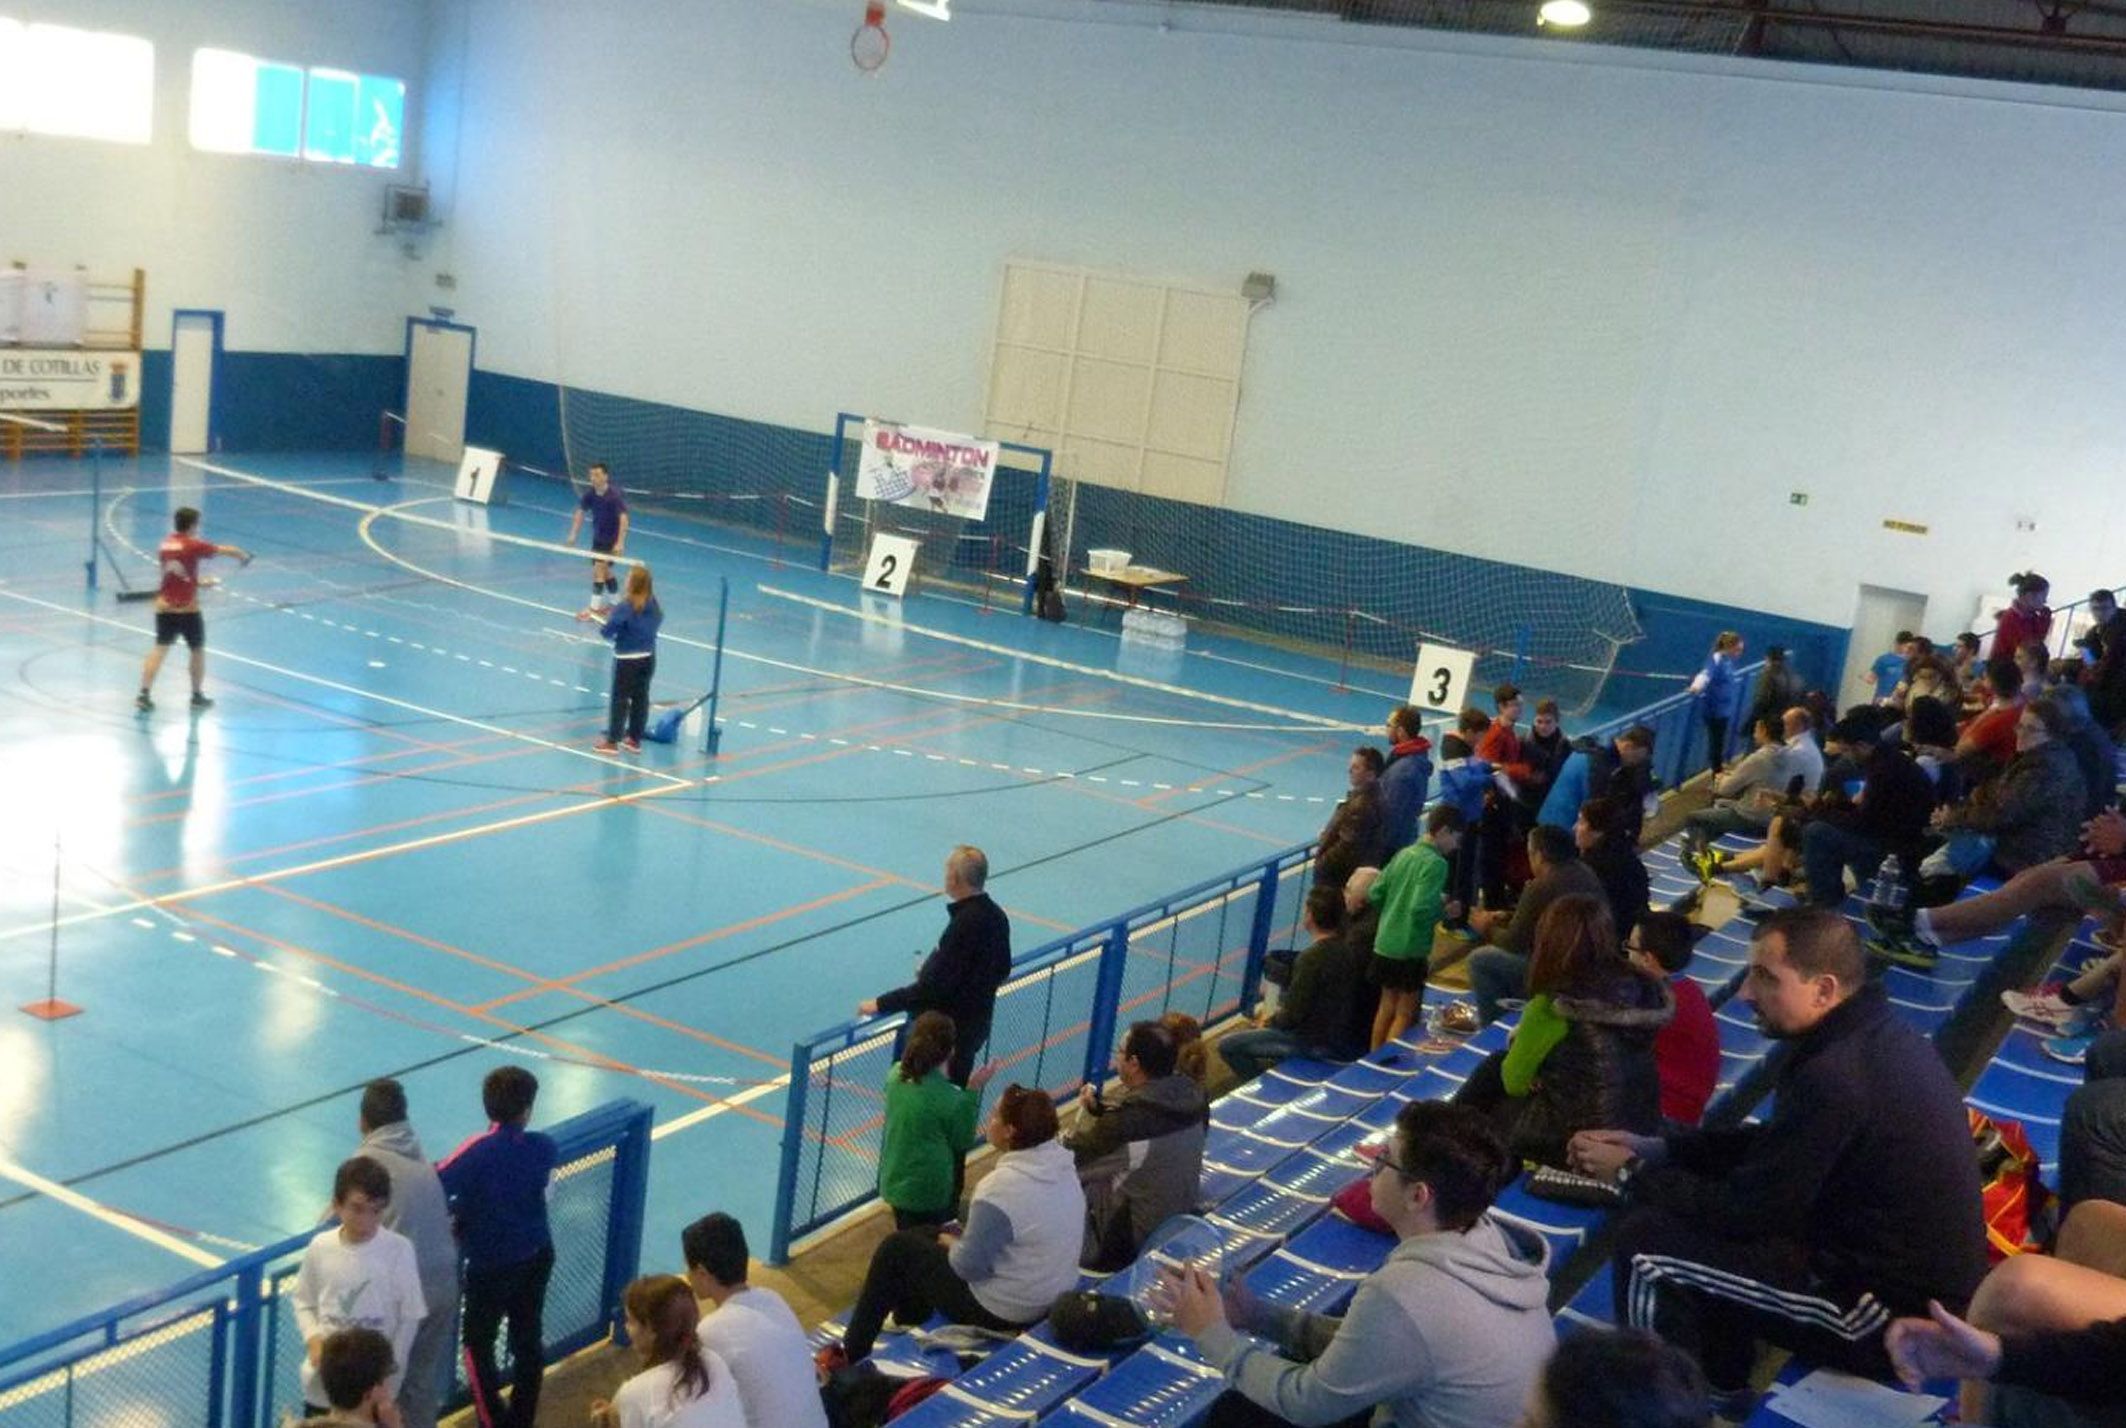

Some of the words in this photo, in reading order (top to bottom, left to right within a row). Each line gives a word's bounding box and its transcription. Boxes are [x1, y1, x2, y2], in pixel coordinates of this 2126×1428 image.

[2, 358, 23, 374] DE
[29, 358, 101, 375] COTILLAS
[875, 431, 989, 468] BADMINTON
[469, 467, 480, 497] 1
[875, 554, 897, 589] 2
[1427, 667, 1451, 706] 3
